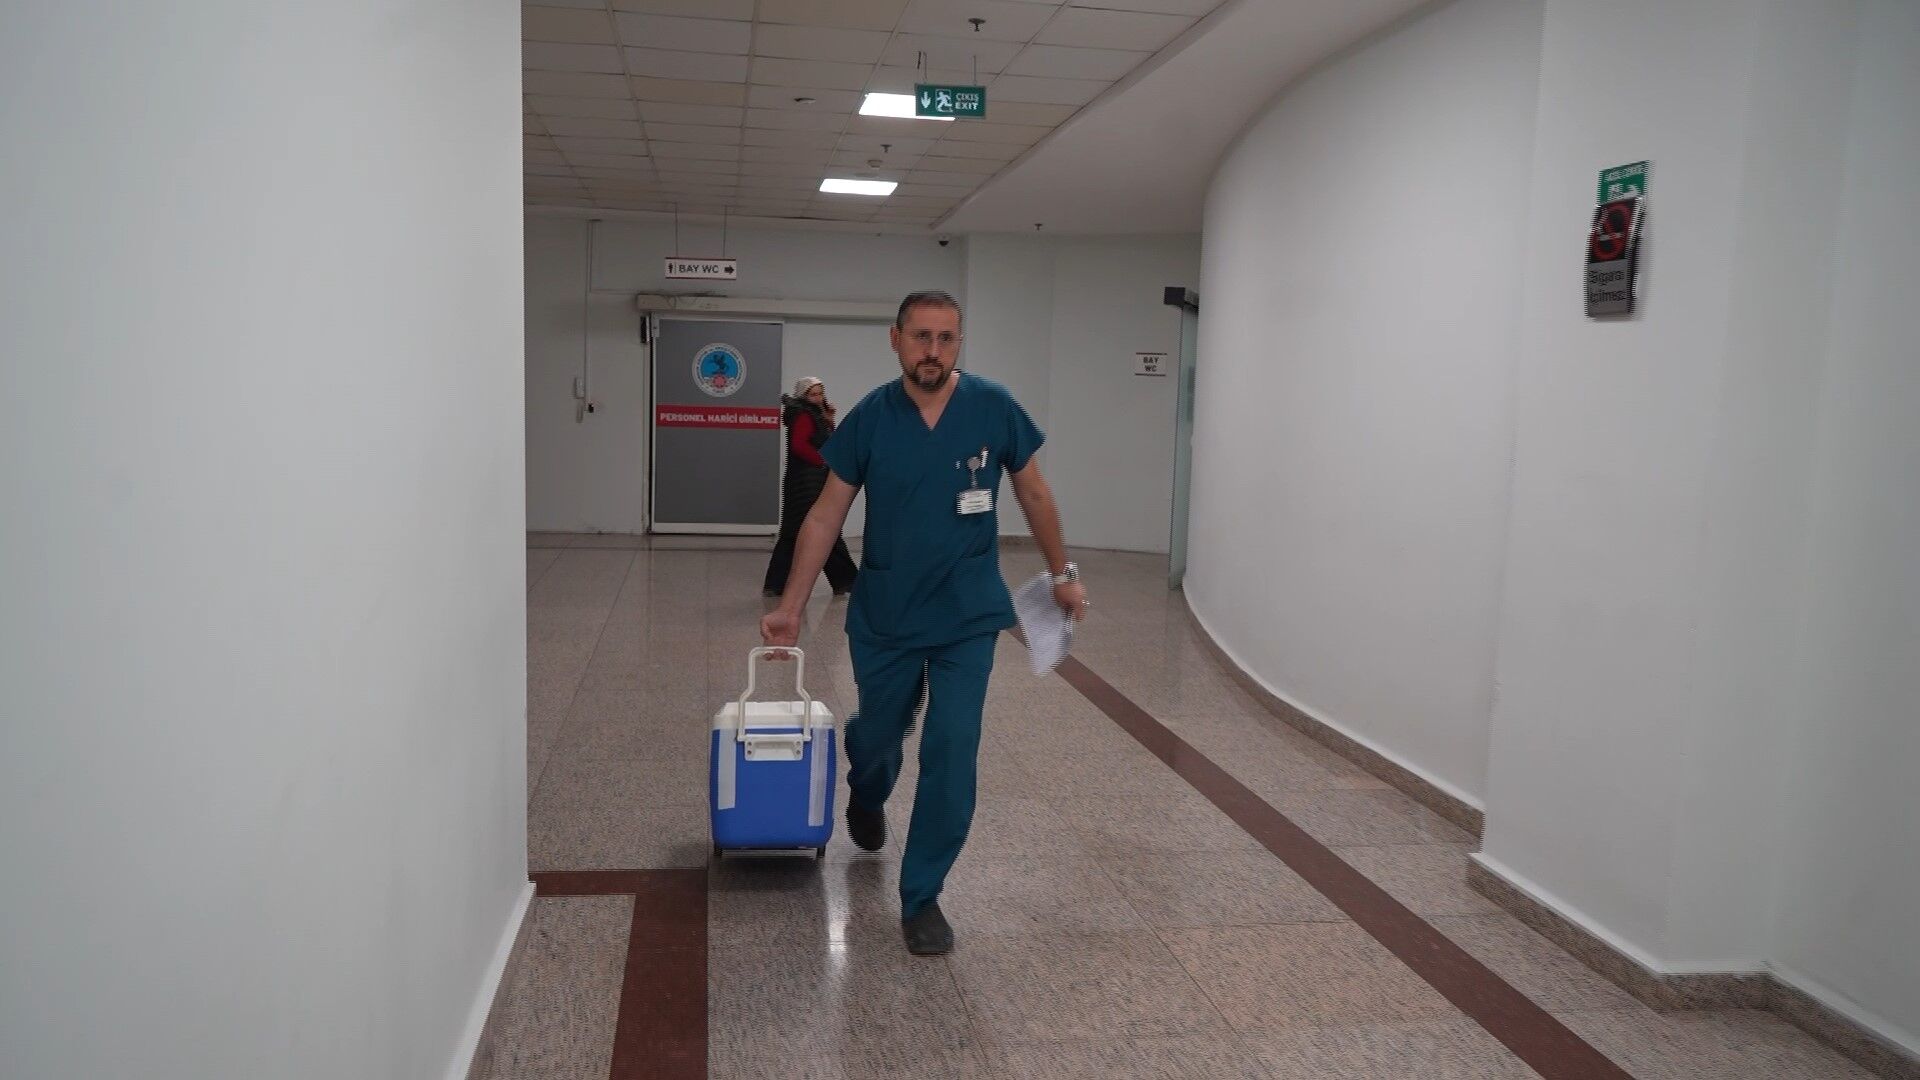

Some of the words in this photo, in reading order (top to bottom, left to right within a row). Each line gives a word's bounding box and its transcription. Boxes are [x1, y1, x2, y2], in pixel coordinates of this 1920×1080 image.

[955, 102, 978, 110] EXIT
[679, 265, 699, 273] BAY
[702, 265, 719, 273] WC
[1589, 270, 1624, 286] Sigara
[660, 413, 705, 422] PERSONEL
[708, 413, 738, 424] HARİCİ
[739, 414, 779, 425] GİRİLMEZ
